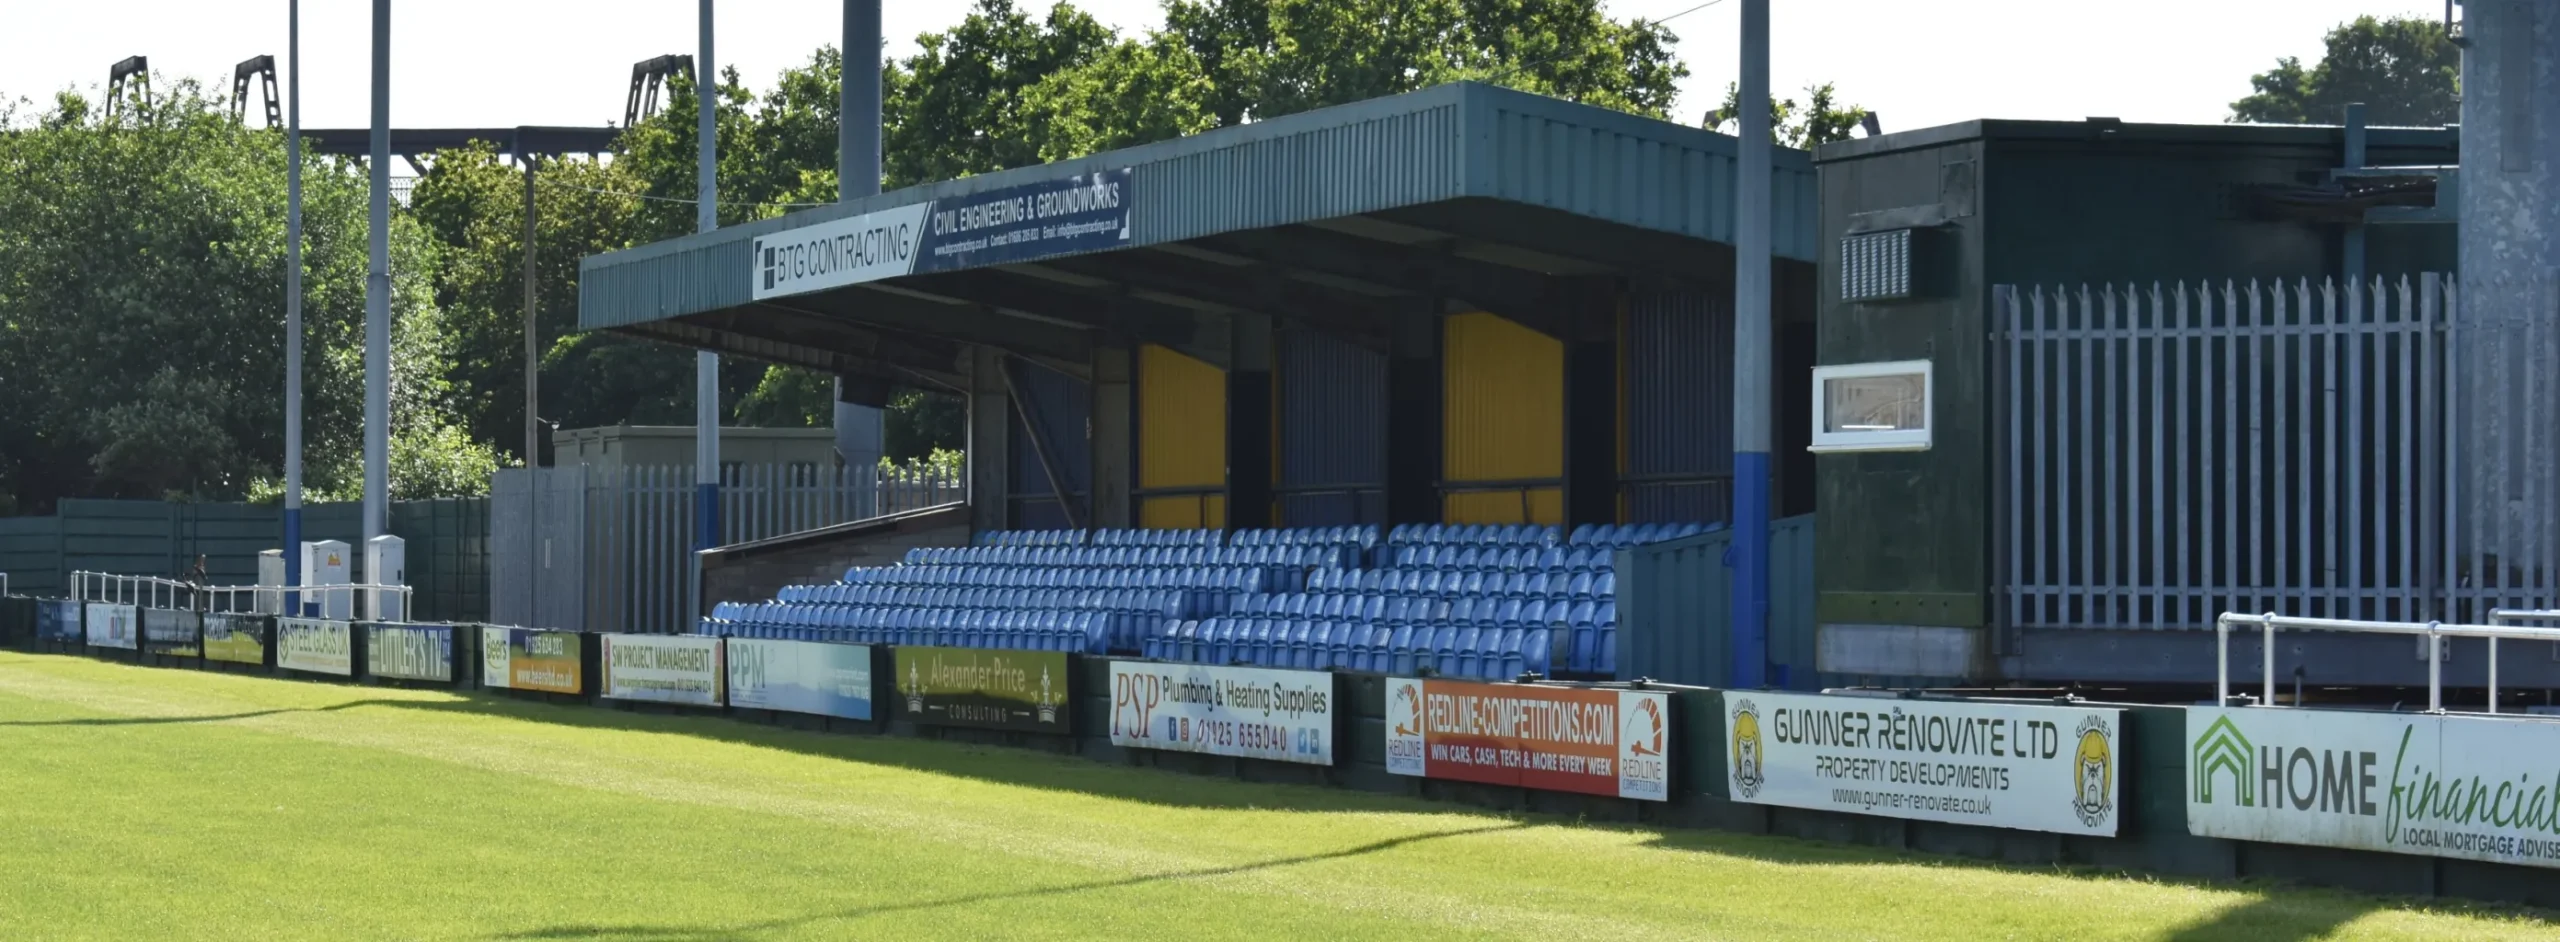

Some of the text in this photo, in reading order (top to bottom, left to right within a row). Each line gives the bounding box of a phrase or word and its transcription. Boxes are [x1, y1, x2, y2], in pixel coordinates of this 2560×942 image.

[935, 182, 1119, 236] CIVIL ENGINEERING & GROUNDWORKS
[778, 223, 909, 282] BTG CONTRACTING
[290, 623, 312, 652] STEEL
[314, 625, 337, 655] GLASS
[380, 628, 426, 677] LITTLER'S
[428, 629, 443, 678] TV
[612, 645, 710, 672] SW PROJECT MANAGEMENT
[729, 643, 766, 689] PPM
[931, 653, 1026, 692] Alexander Price
[950, 704, 1007, 722] CONSULTING
[1113, 672, 1159, 739] PSP
[1163, 675, 1327, 719] Plumbing & Heating Supplies
[1197, 719, 1287, 751] 01925 655040
[1427, 693, 1614, 746] REDLINE-COMPETITIONS.COM
[1774, 708, 2058, 760] GUNNER RENOVATE LTD
[2076, 714, 2111, 741] GUNNER
[1388, 739, 1421, 758] REDLINE
[1431, 743, 1612, 777] WIN CARS, CASH, TECH & MORE EVERY WEEK
[1623, 758, 1661, 780] REDLINE
[1816, 755, 2010, 790] PROPERTY DEVELOPMENTS
[2261, 745, 2377, 816] HOME
[1832, 789, 1992, 815] www.gunner-renovate.co.uk
[2072, 797, 2113, 828] RENOVATE
[2403, 827, 2441, 848] LOCAL
[2443, 831, 2514, 855] MORTGAGE
